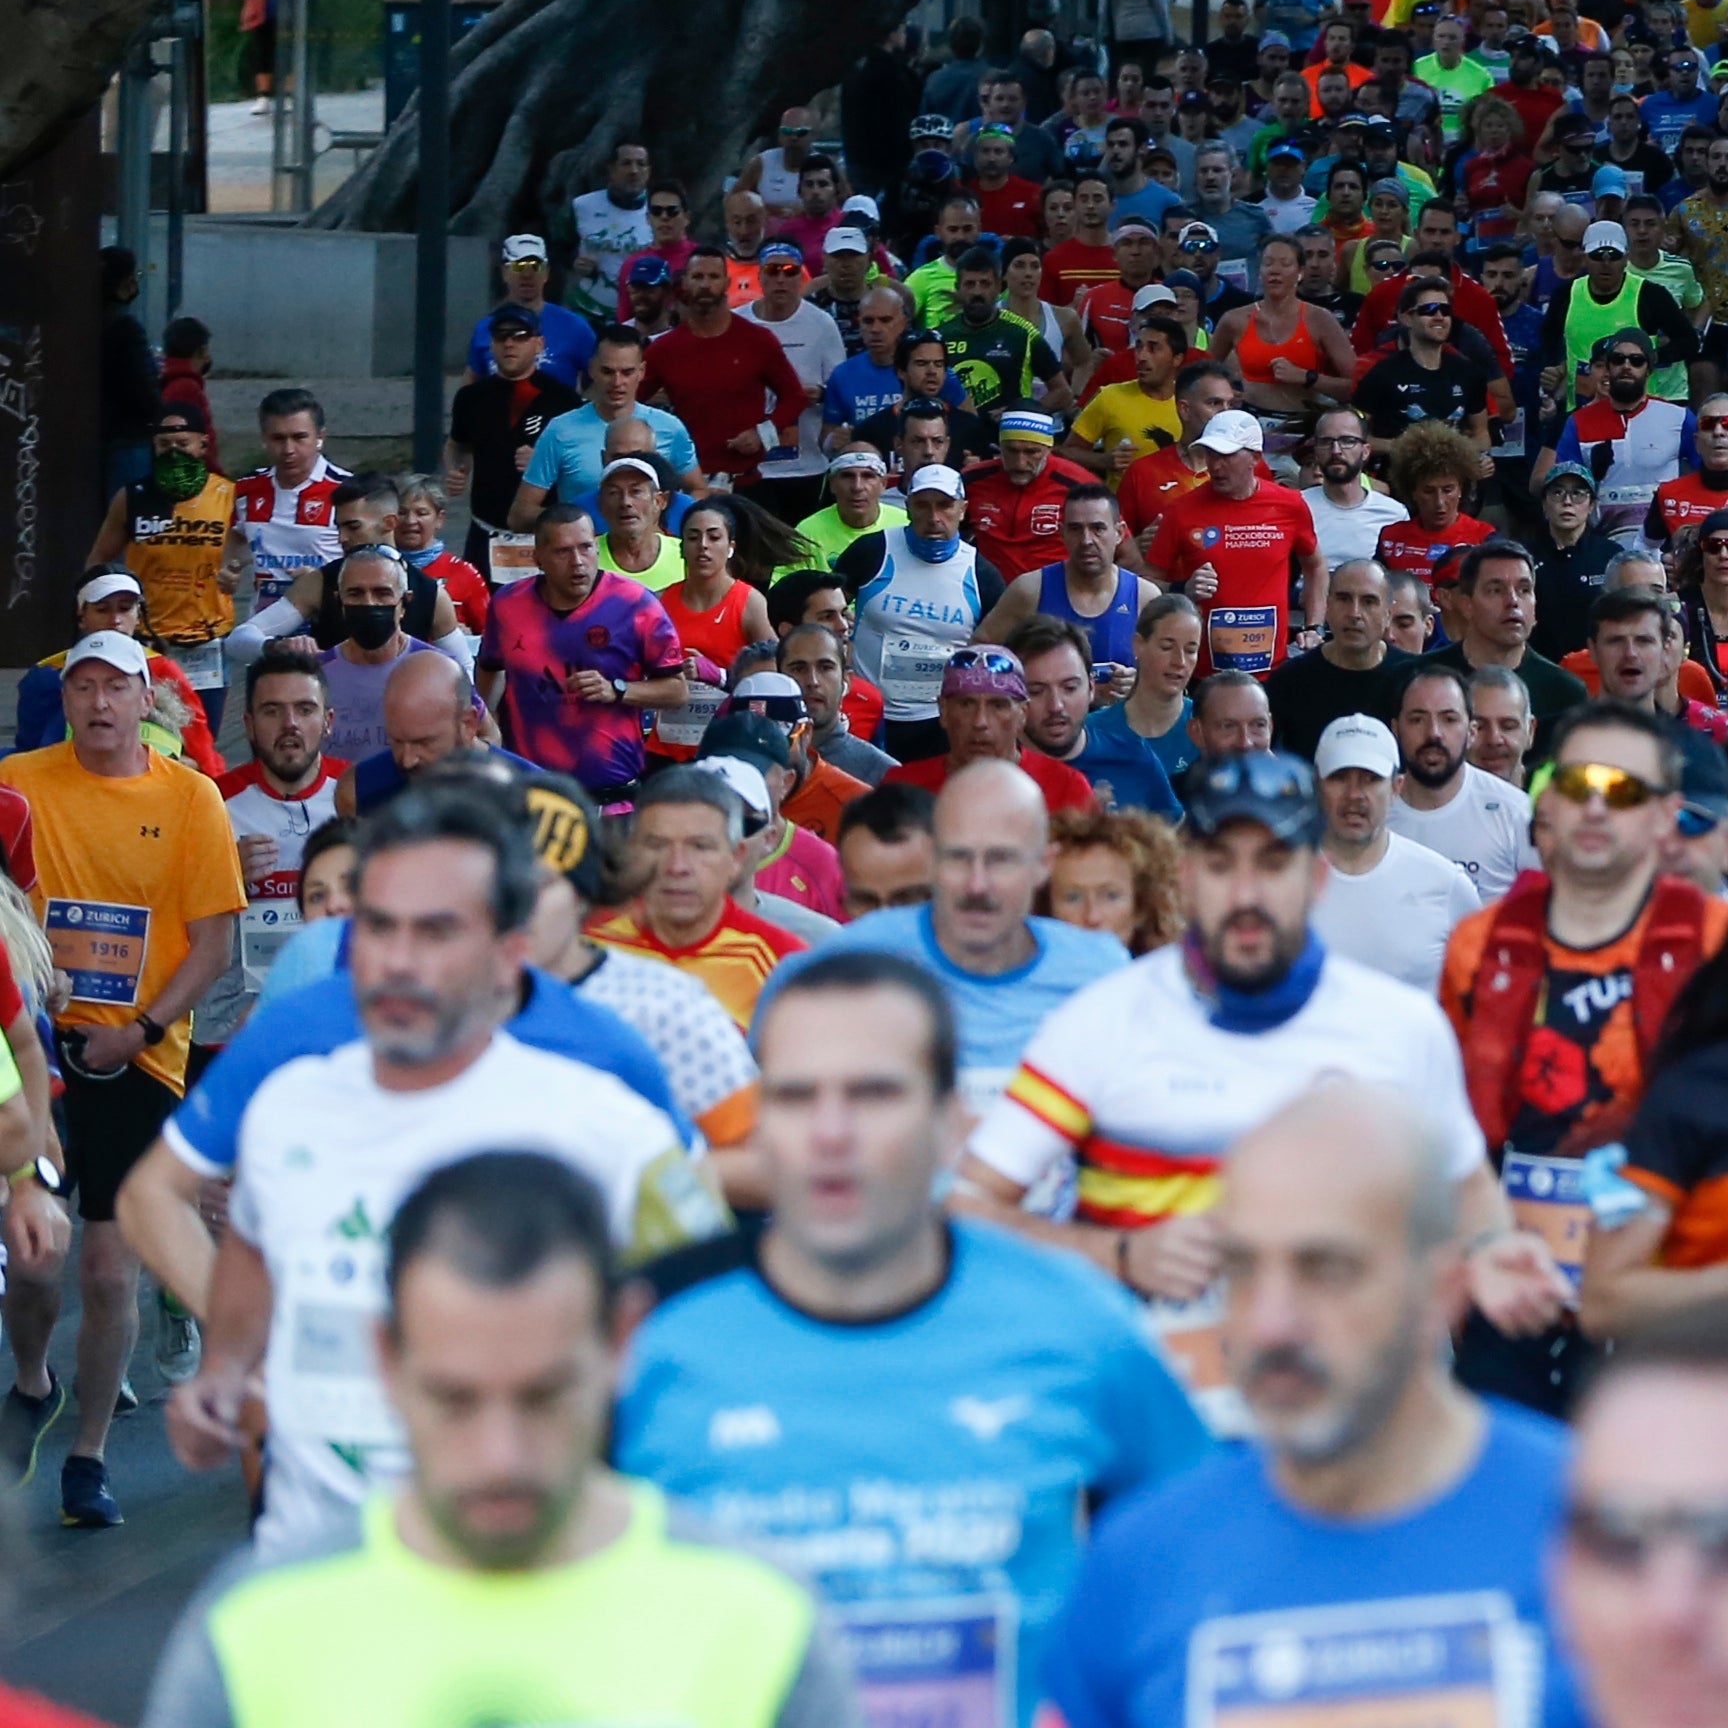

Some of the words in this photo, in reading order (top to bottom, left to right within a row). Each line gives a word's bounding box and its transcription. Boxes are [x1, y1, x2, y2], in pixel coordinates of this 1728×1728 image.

[856, 395, 877, 406] WE
[135, 515, 224, 534] bichos
[881, 594, 965, 626] ITALIA
[1237, 612, 1265, 622] ZURICH
[1242, 633, 1265, 643] 2091
[914, 662, 944, 673] 9299
[688, 703, 716, 714] 7893
[85, 909, 131, 926] ZURICH
[91, 941, 129, 958] 1916
